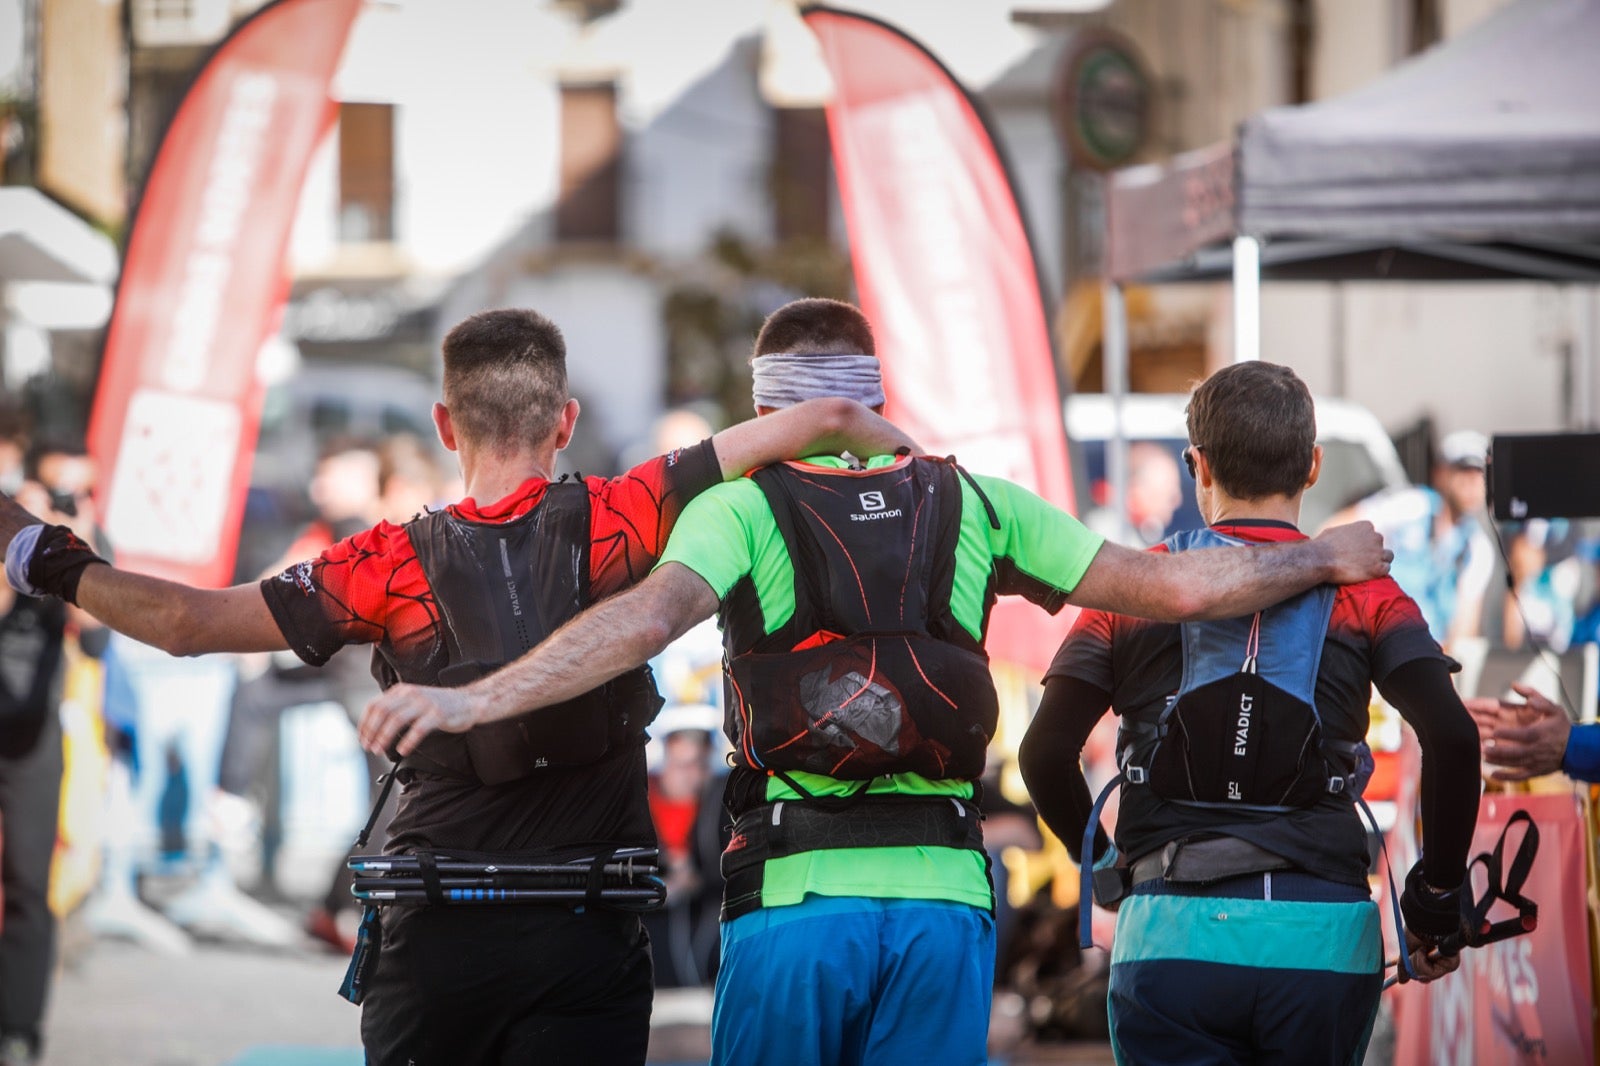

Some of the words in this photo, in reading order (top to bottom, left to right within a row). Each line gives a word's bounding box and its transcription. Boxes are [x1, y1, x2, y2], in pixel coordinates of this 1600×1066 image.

[507, 581, 521, 616] EVADICT
[1234, 693, 1253, 756] EVADICT
[1229, 781, 1241, 796] 5L
